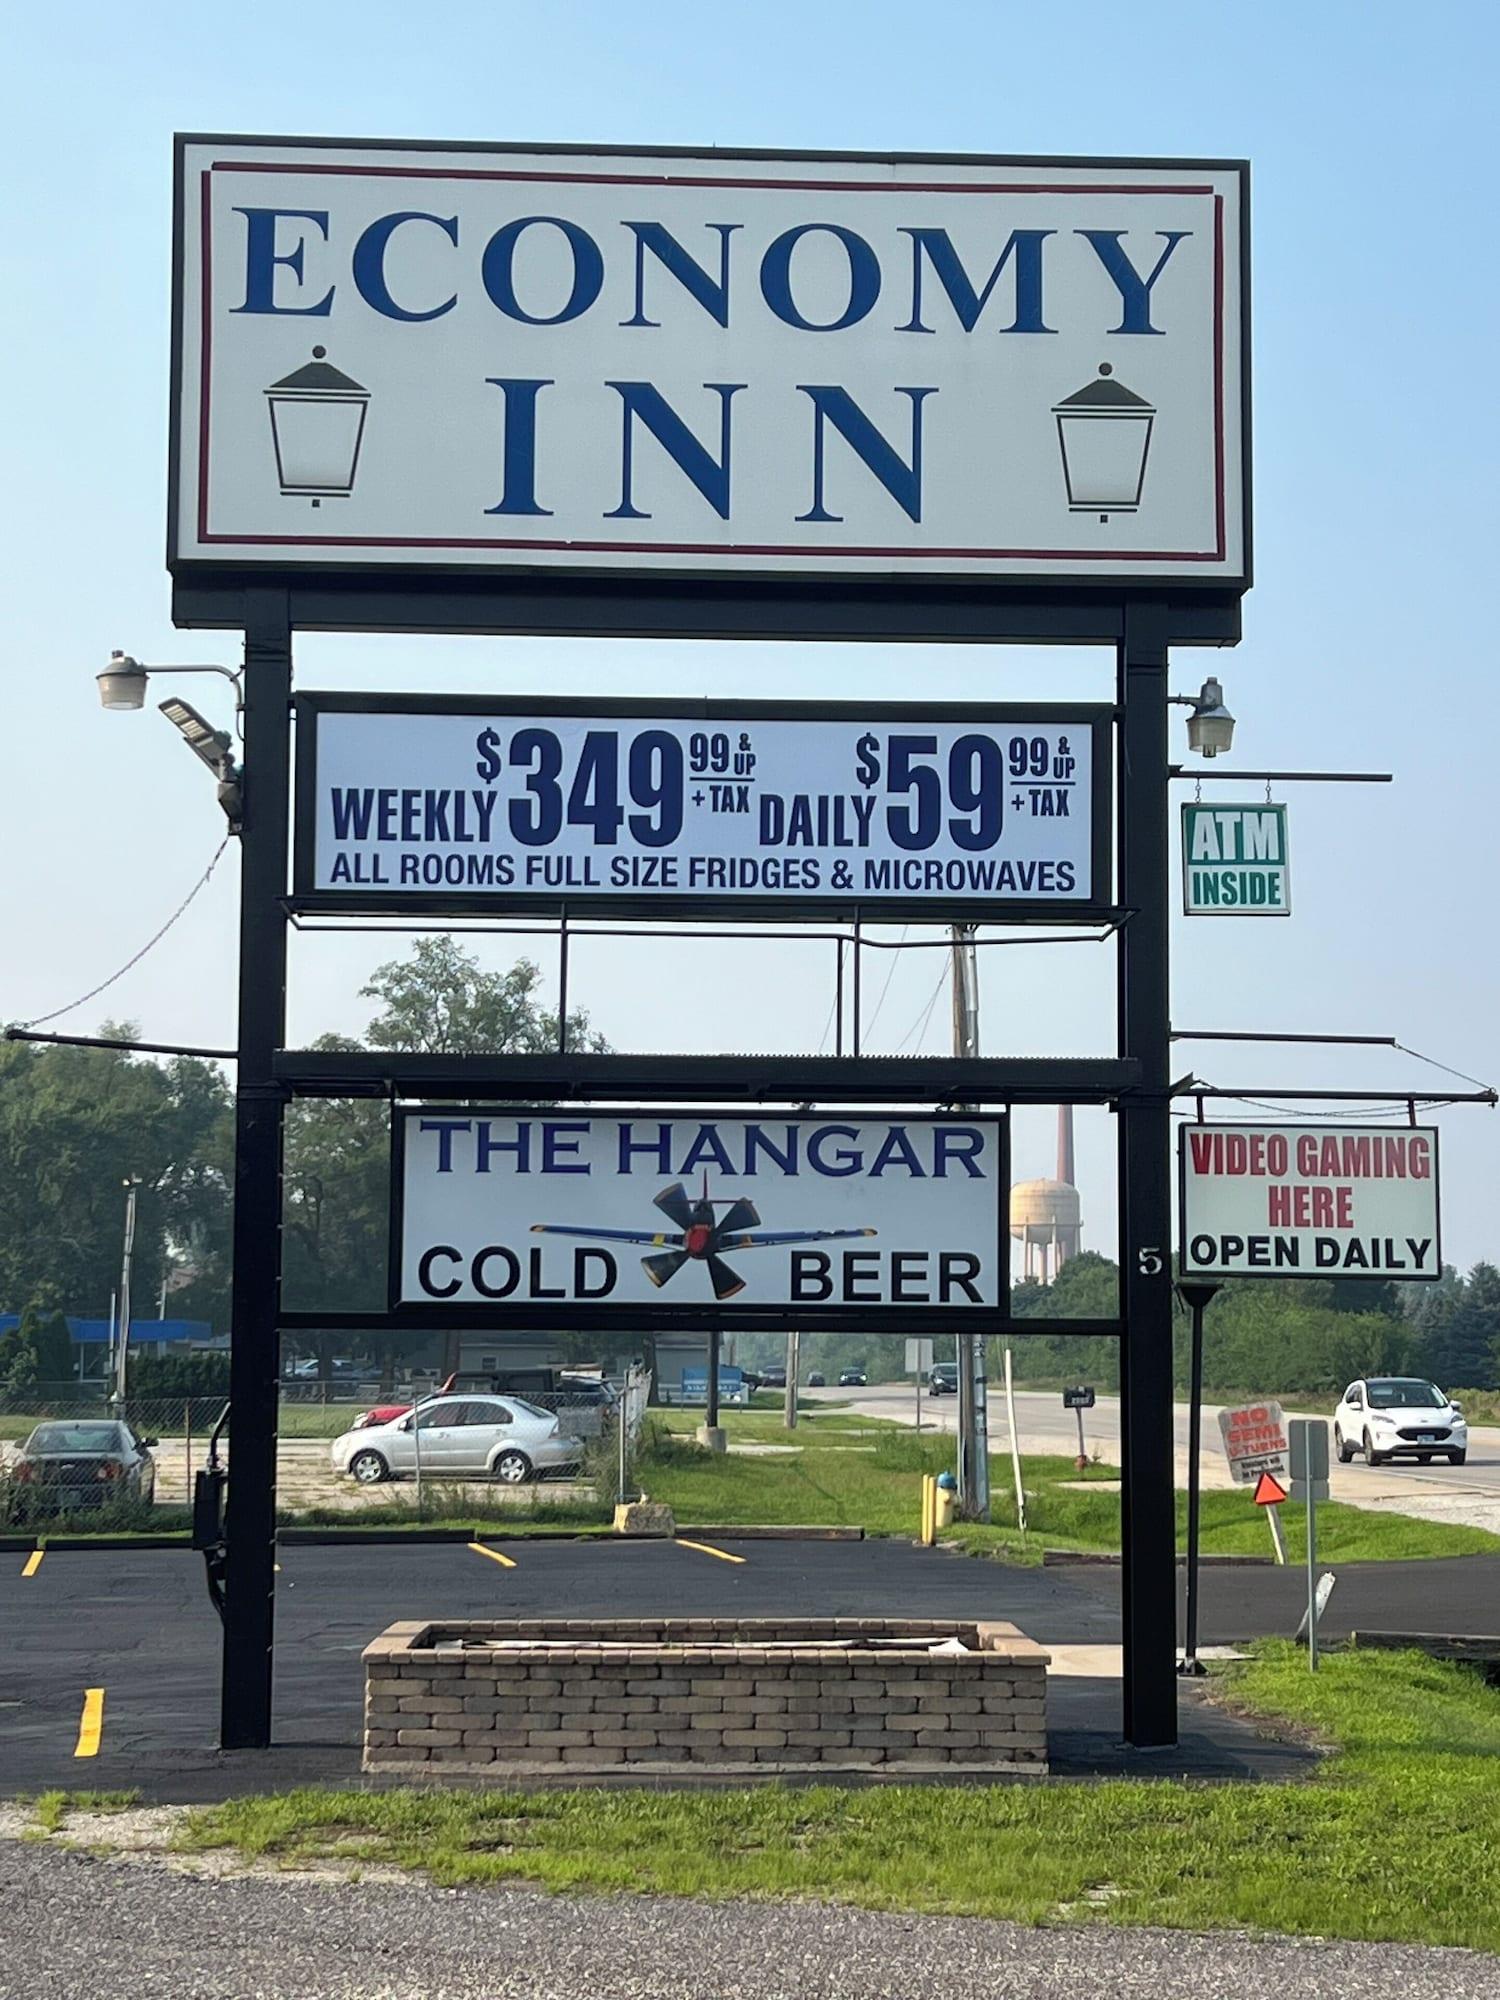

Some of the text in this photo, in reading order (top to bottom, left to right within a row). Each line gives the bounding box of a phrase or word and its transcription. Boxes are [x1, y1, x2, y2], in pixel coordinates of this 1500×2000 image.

[229, 206, 1194, 336] ECONOMY
[484, 377, 940, 524] INN
[733, 752, 756, 776] UP
[1053, 756, 1076, 780] UP
[330, 787, 498, 843] WEEKLY
[759, 793, 877, 848] DAILY
[1191, 811, 1280, 861] ATM
[330, 853, 1076, 892] ALL ROOMS FULL SIZE FRIDGES & MICROWAVES
[1192, 871, 1281, 906] INSIDE
[420, 1119, 987, 1179] THE HANGAR
[1190, 1133, 1430, 1180] VIDEO GAMING
[1268, 1185, 1355, 1229] HERE
[417, 1245, 985, 1303] COLD BEER
[1138, 1247, 1163, 1275] 5
[1190, 1234, 1432, 1270] OPEN DAILY
[1231, 1407, 1269, 1426] NO
